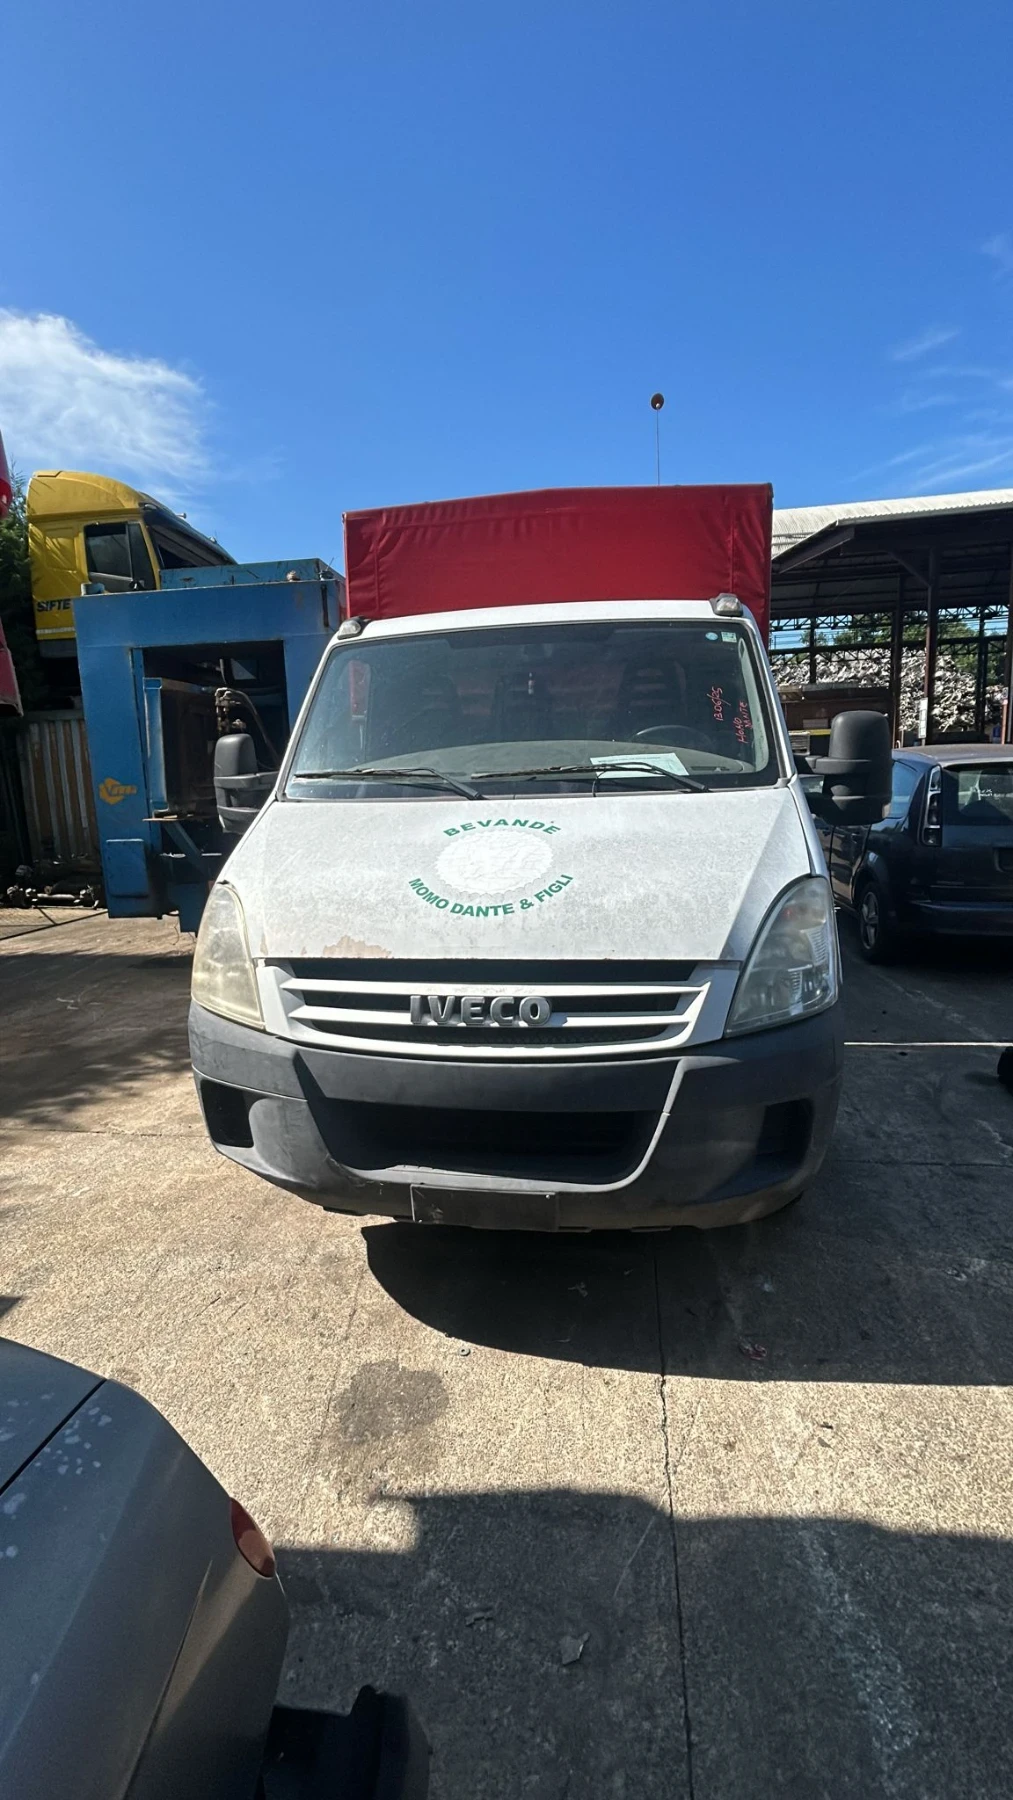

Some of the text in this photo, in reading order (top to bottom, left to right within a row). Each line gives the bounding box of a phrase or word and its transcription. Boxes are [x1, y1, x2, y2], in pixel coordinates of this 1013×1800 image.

[443, 819, 561, 837] BEVANDE
[408, 874, 574, 917] MOMO DANTE & FIGLI
[410, 995, 551, 1026] IVECO
